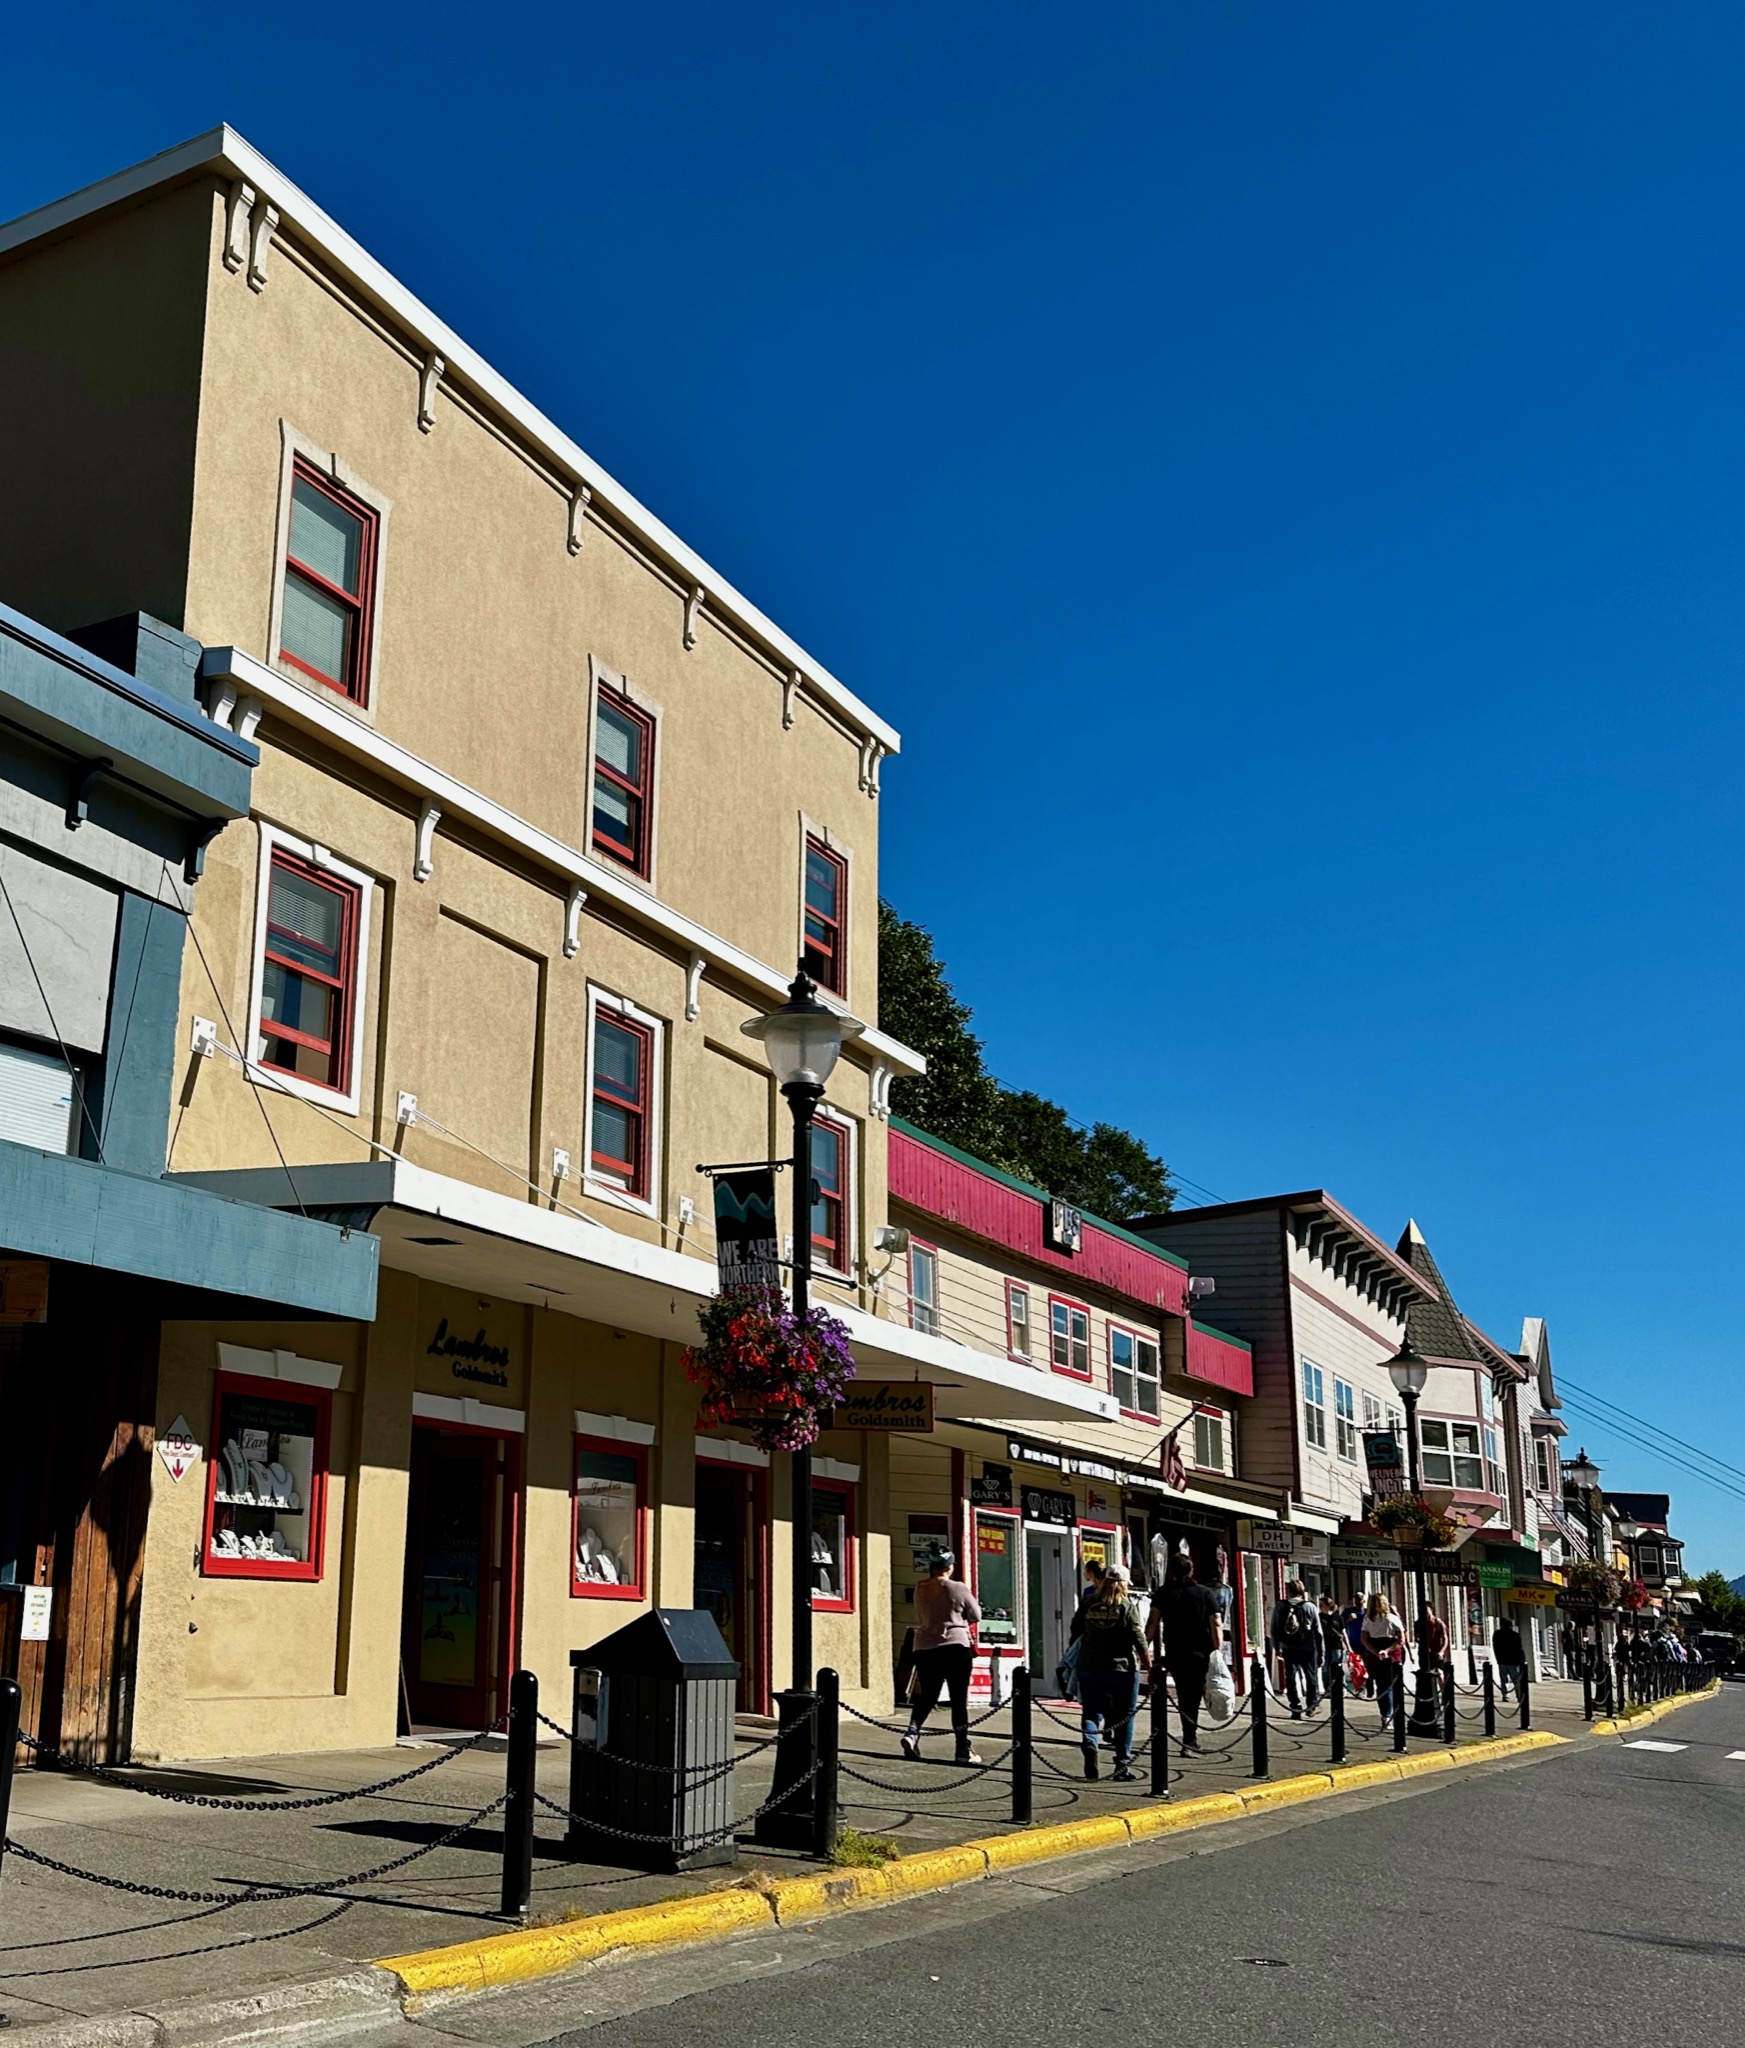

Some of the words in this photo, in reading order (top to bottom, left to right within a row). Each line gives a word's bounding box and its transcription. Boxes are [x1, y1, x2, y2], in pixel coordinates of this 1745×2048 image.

[718, 1240, 742, 1266] WE
[746, 1237, 778, 1264] ARE
[719, 1263, 779, 1285] NORTHERN
[427, 1319, 509, 1366] Lambros
[452, 1361, 508, 1387] Goldsmith
[836, 1385, 926, 1411] ambros
[847, 1412, 926, 1427] Goldsmith
[166, 1433, 193, 1451] FDC
[972, 1489, 1011, 1500] GARY'S
[1042, 1495, 1072, 1518] GARY'S
[1262, 1531, 1283, 1541] DH
[1256, 1541, 1290, 1550] JEWELRY
[1346, 1549, 1379, 1557] SHIVAS
[1518, 1590, 1537, 1599] MK
